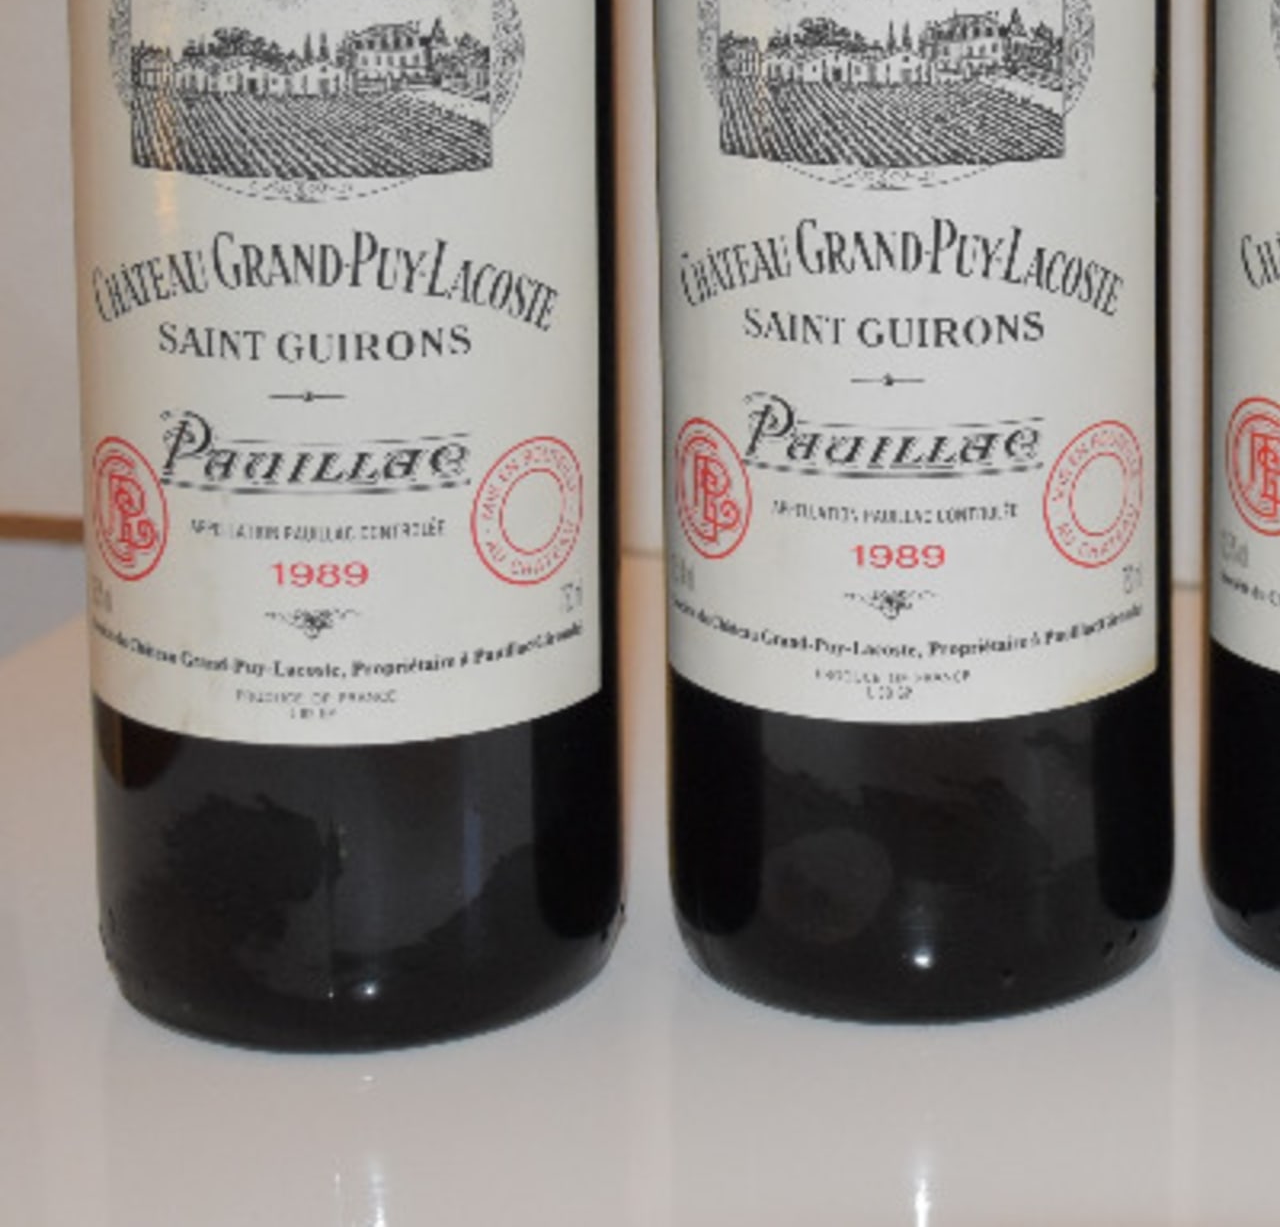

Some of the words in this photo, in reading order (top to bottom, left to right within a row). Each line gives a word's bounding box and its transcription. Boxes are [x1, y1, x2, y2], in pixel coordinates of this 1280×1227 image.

[159, 321, 266, 362] SAINT
[277, 323, 472, 365] GUIRONS
[744, 308, 846, 345] SAINT
[857, 310, 1045, 349] GUIRONS
[271, 560, 370, 589] 1989
[850, 544, 946, 570] 1989
